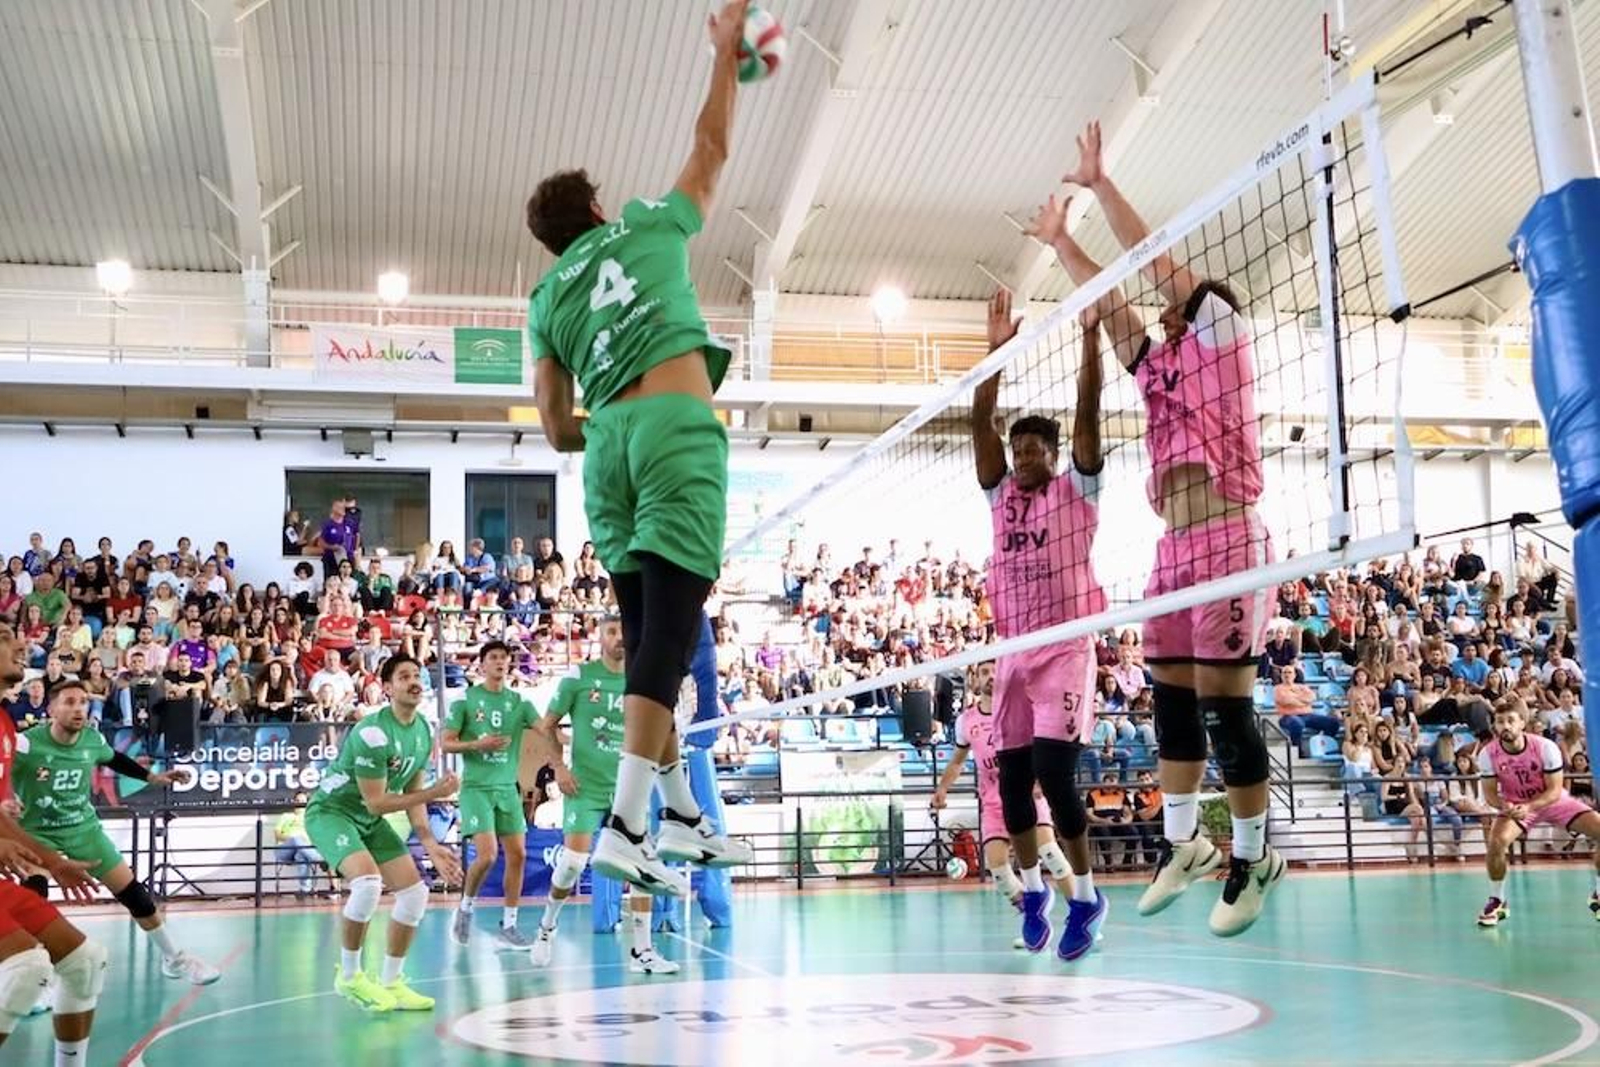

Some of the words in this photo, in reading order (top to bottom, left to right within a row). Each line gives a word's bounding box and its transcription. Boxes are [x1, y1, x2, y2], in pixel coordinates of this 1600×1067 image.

[1256, 123, 1309, 171] rfevb.com
[589, 257, 639, 313] 4
[327, 338, 446, 364] Andalucía
[1005, 495, 1032, 524] 57
[1229, 598, 1244, 623] 5
[607, 692, 625, 713] 14
[1062, 691, 1082, 713] 57
[491, 710, 502, 728] 6
[307, 740, 339, 761] de
[52, 768, 84, 791] 23
[172, 763, 327, 798] Deporte
[1514, 769, 1533, 786] 12
